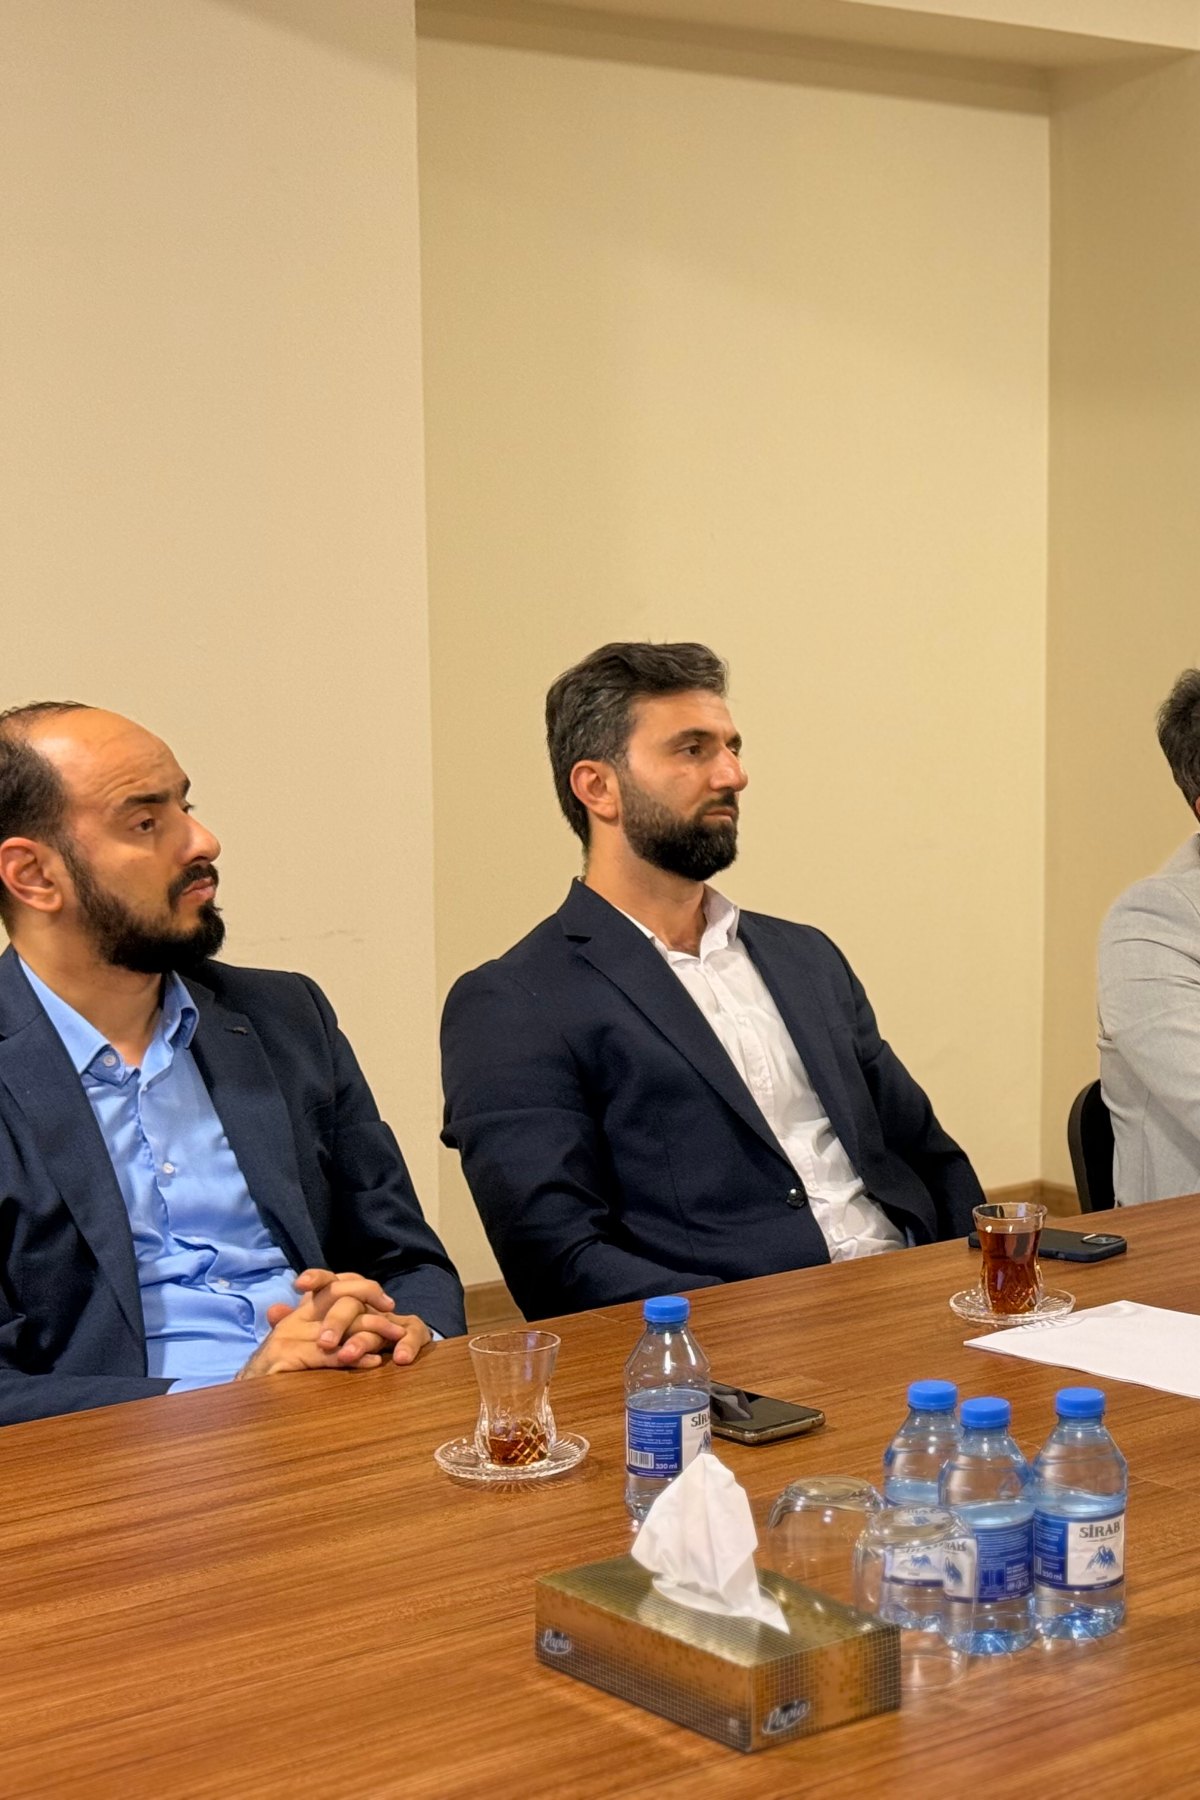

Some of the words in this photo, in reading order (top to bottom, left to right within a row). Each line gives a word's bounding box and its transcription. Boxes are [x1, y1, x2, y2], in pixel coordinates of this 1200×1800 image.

[1079, 1521, 1121, 1539] SİRAB
[542, 1629, 571, 1653] Papia
[764, 1700, 808, 1733] Papia
